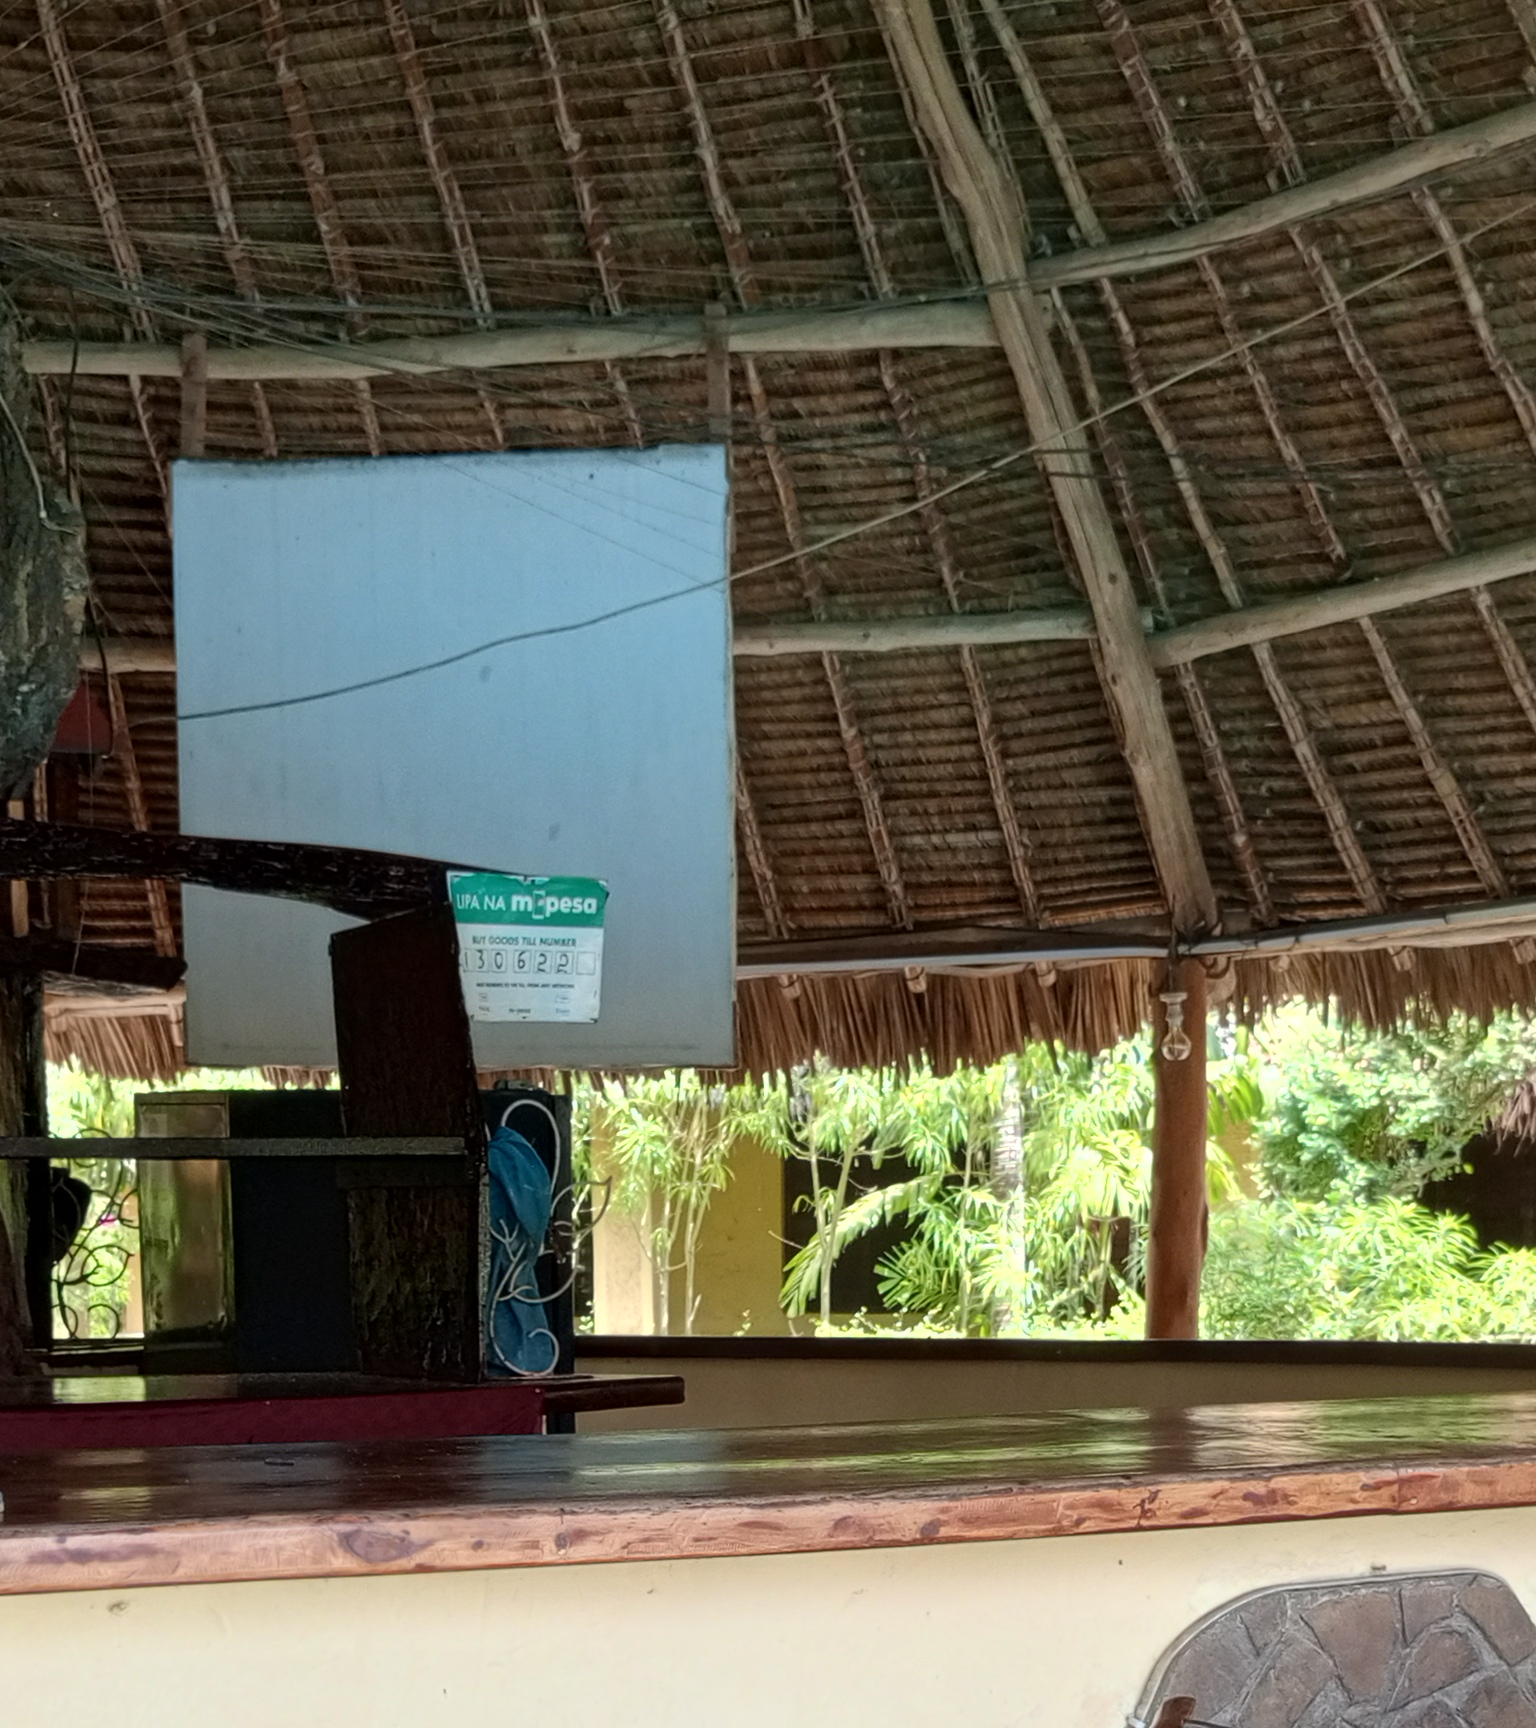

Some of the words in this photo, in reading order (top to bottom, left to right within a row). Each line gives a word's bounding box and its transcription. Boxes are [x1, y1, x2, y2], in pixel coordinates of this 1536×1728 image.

[483, 895, 506, 912] NA
[488, 936, 519, 946] GOODS
[521, 936, 537, 946] TILL
[539, 937, 577, 947] NUMBER
